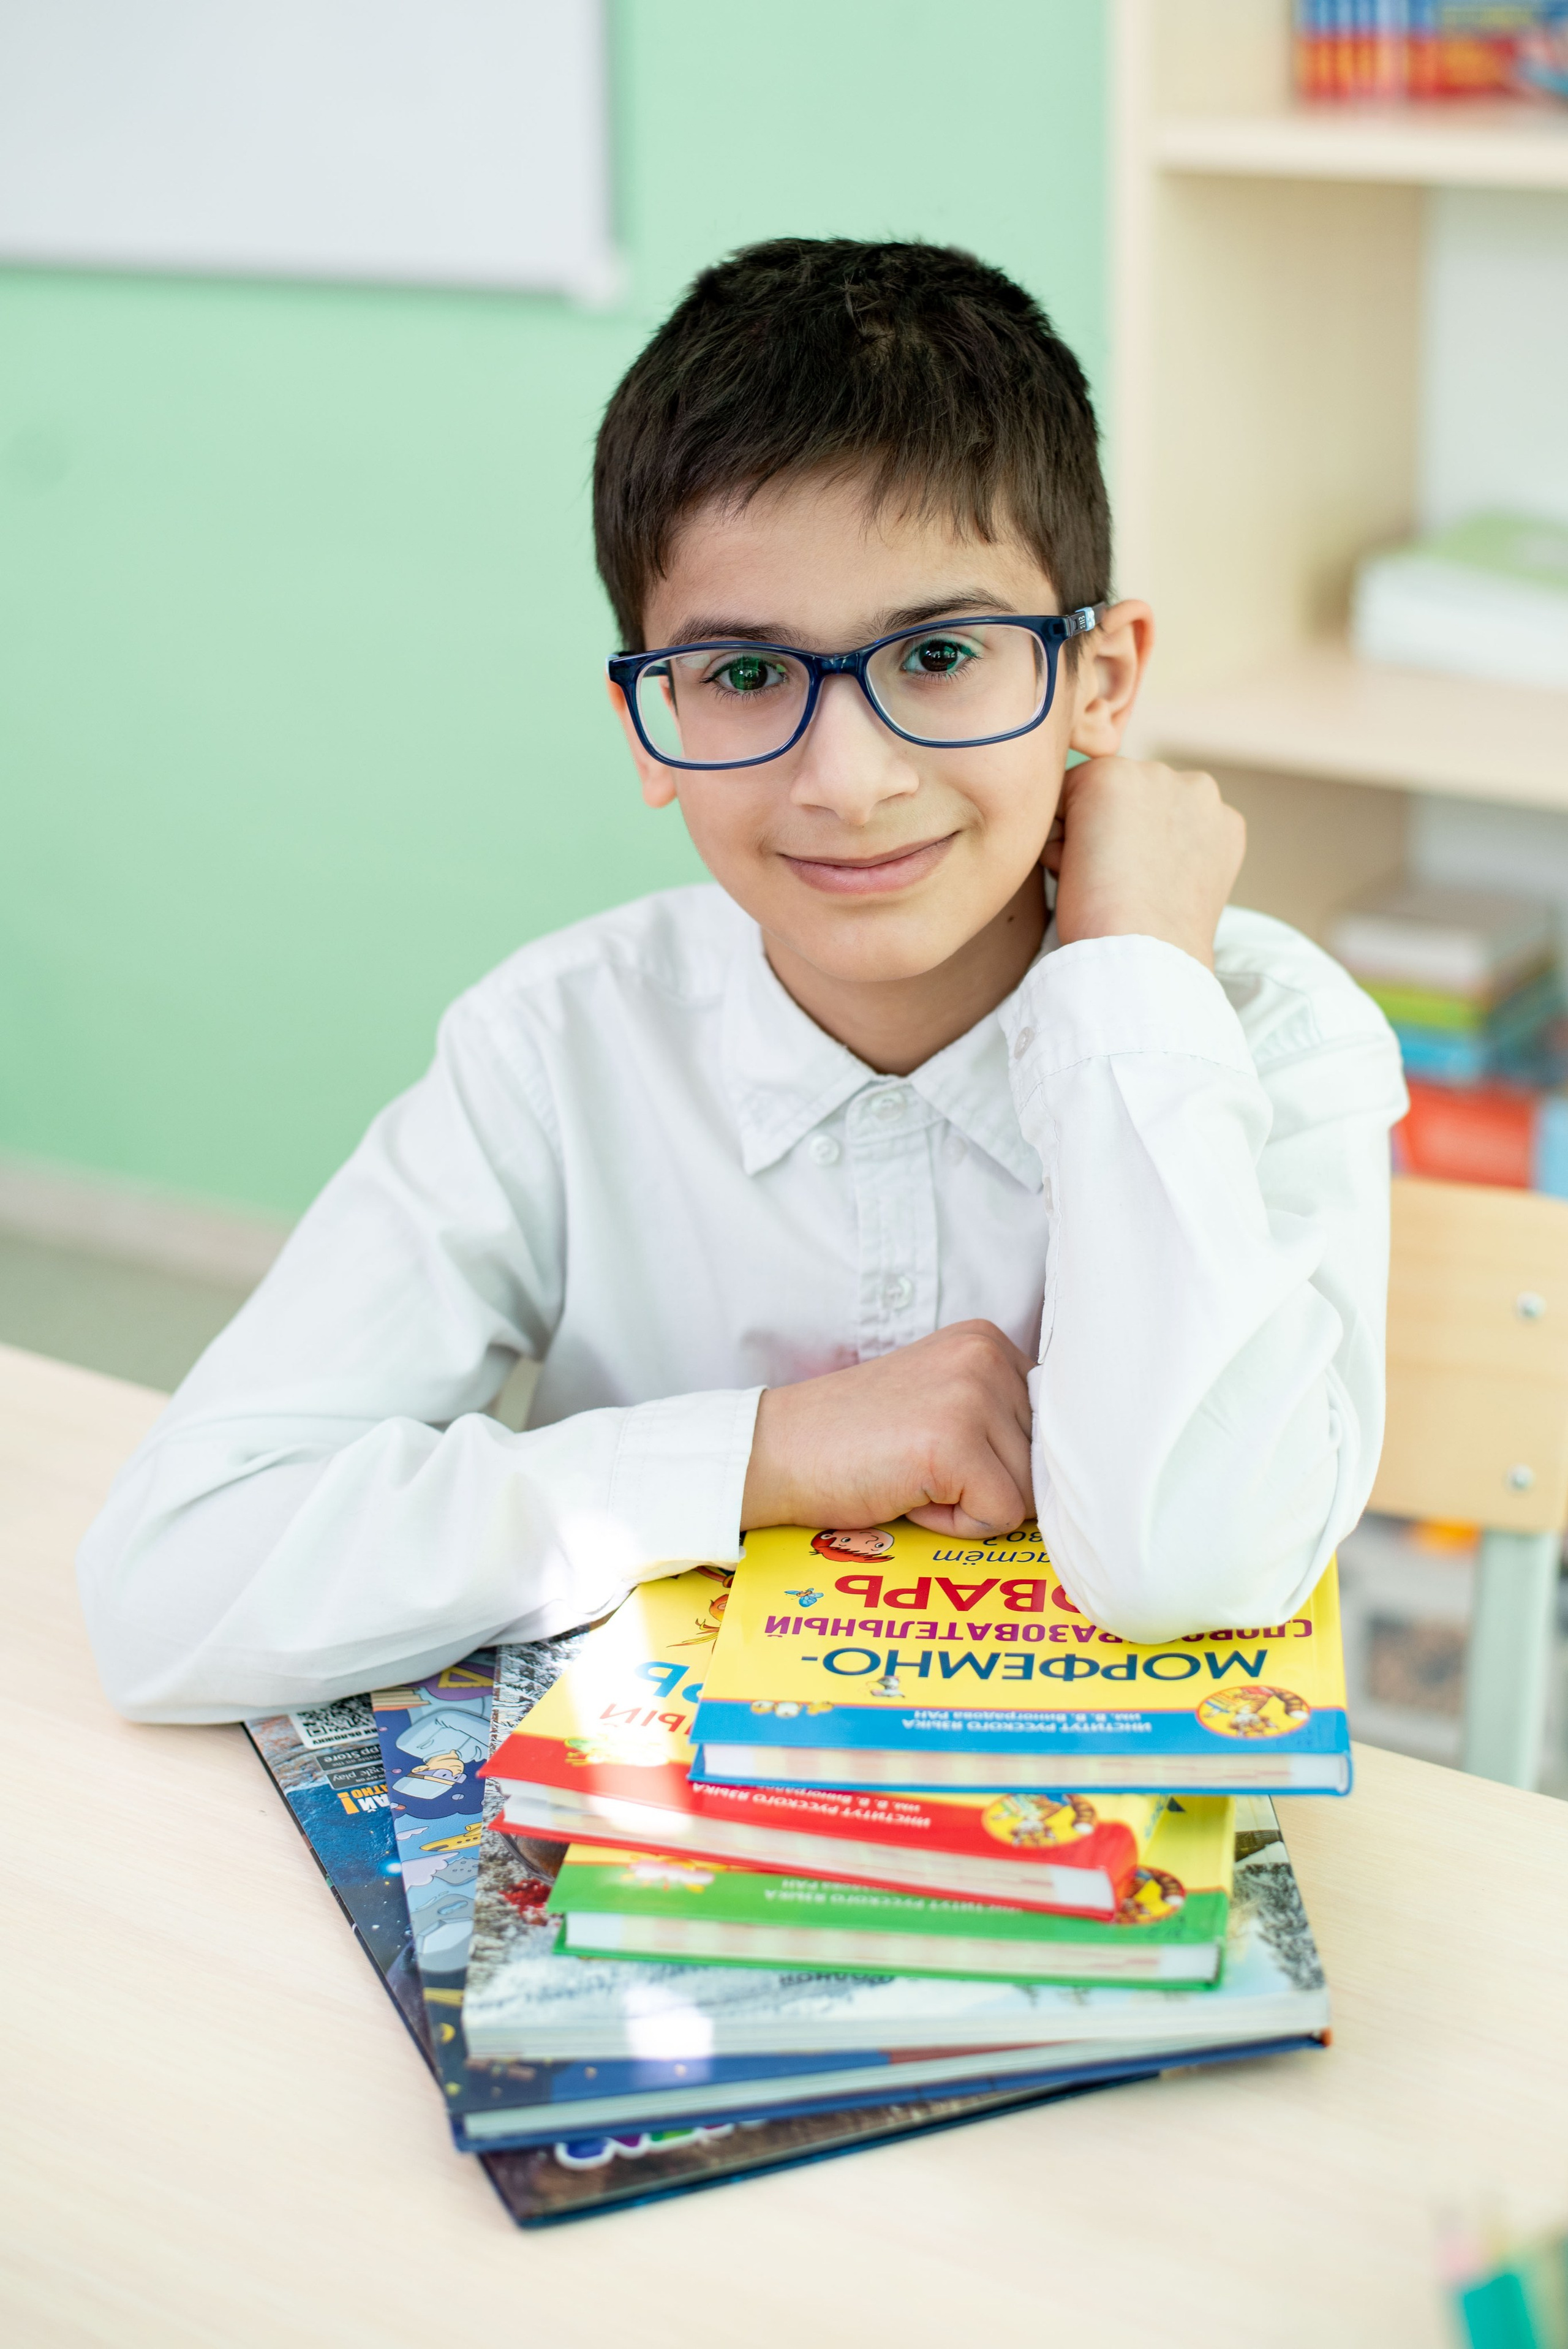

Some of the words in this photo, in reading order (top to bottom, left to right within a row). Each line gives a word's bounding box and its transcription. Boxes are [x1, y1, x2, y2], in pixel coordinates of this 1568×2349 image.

[801, 1648, 1268, 1682] МОРФЕМНО-
[599, 1703, 693, 1735] ЫЙ
[914, 1710, 949, 1720] РАН
[902, 1719, 963, 1732] ЯЗЫКА
[967, 1721, 1056, 1733] РУССКОГО
[1059, 1721, 1152, 1733] ИНСТИТУТ
[360, 1746, 380, 1755] pp
[324, 1751, 360, 1763] Store
[333, 1771, 356, 1782] play
[693, 1782, 751, 1801] ЯЗЫКА
[752, 1793, 840, 1815] РУССКОГО
[841, 1808, 932, 1829] ИНСТИТУТ
